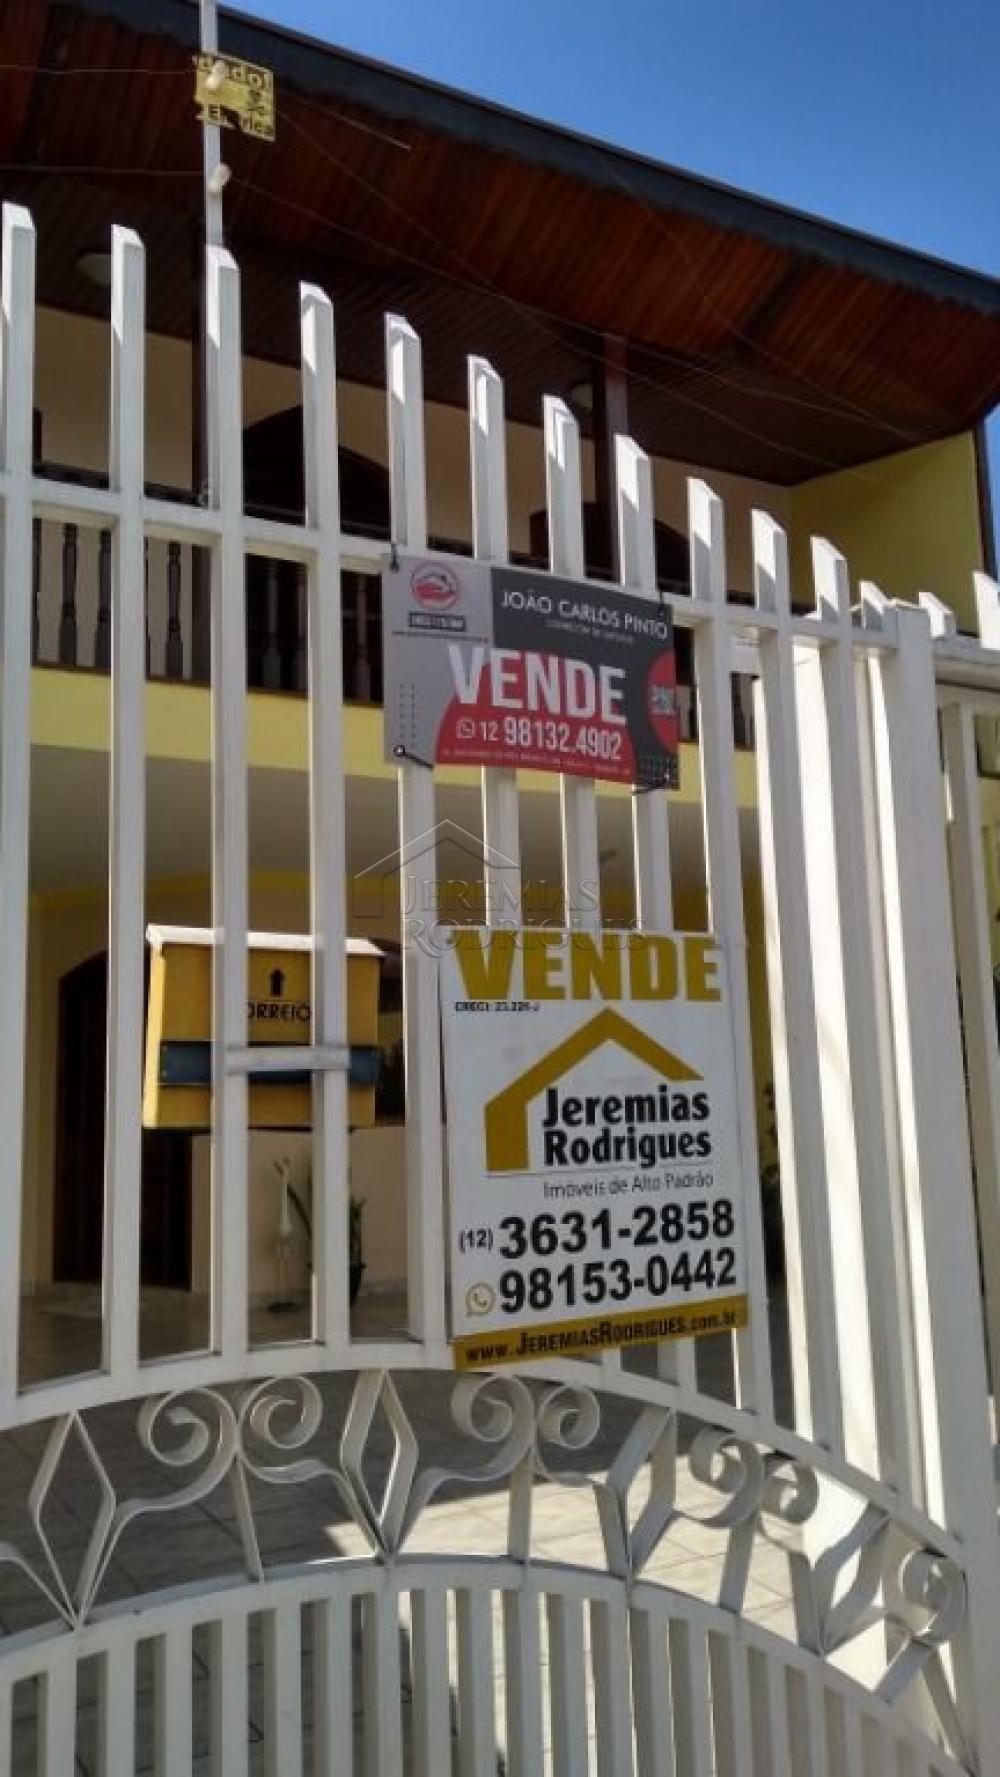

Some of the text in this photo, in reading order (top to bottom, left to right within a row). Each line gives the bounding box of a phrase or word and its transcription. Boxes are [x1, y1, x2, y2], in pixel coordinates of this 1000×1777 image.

[502, 589, 552, 614] JOÃO
[559, 600, 619, 628] CARLOS
[624, 612, 668, 640] PINTO
[448, 645, 627, 726] VENDE
[480, 716, 621, 760] 12 98132.4902
[450, 929, 724, 1002] VENDE
[247, 1001, 311, 1021] ORREIO
[542, 1084, 711, 1128] Jeremias
[543, 1126, 712, 1169] Rodrigues
[607, 1178, 629, 1195] de
[631, 1174, 661, 1193] Alto
[459, 1199, 735, 1260] (12) 3631-2858
[499, 1246, 737, 1314] 98153-0442
